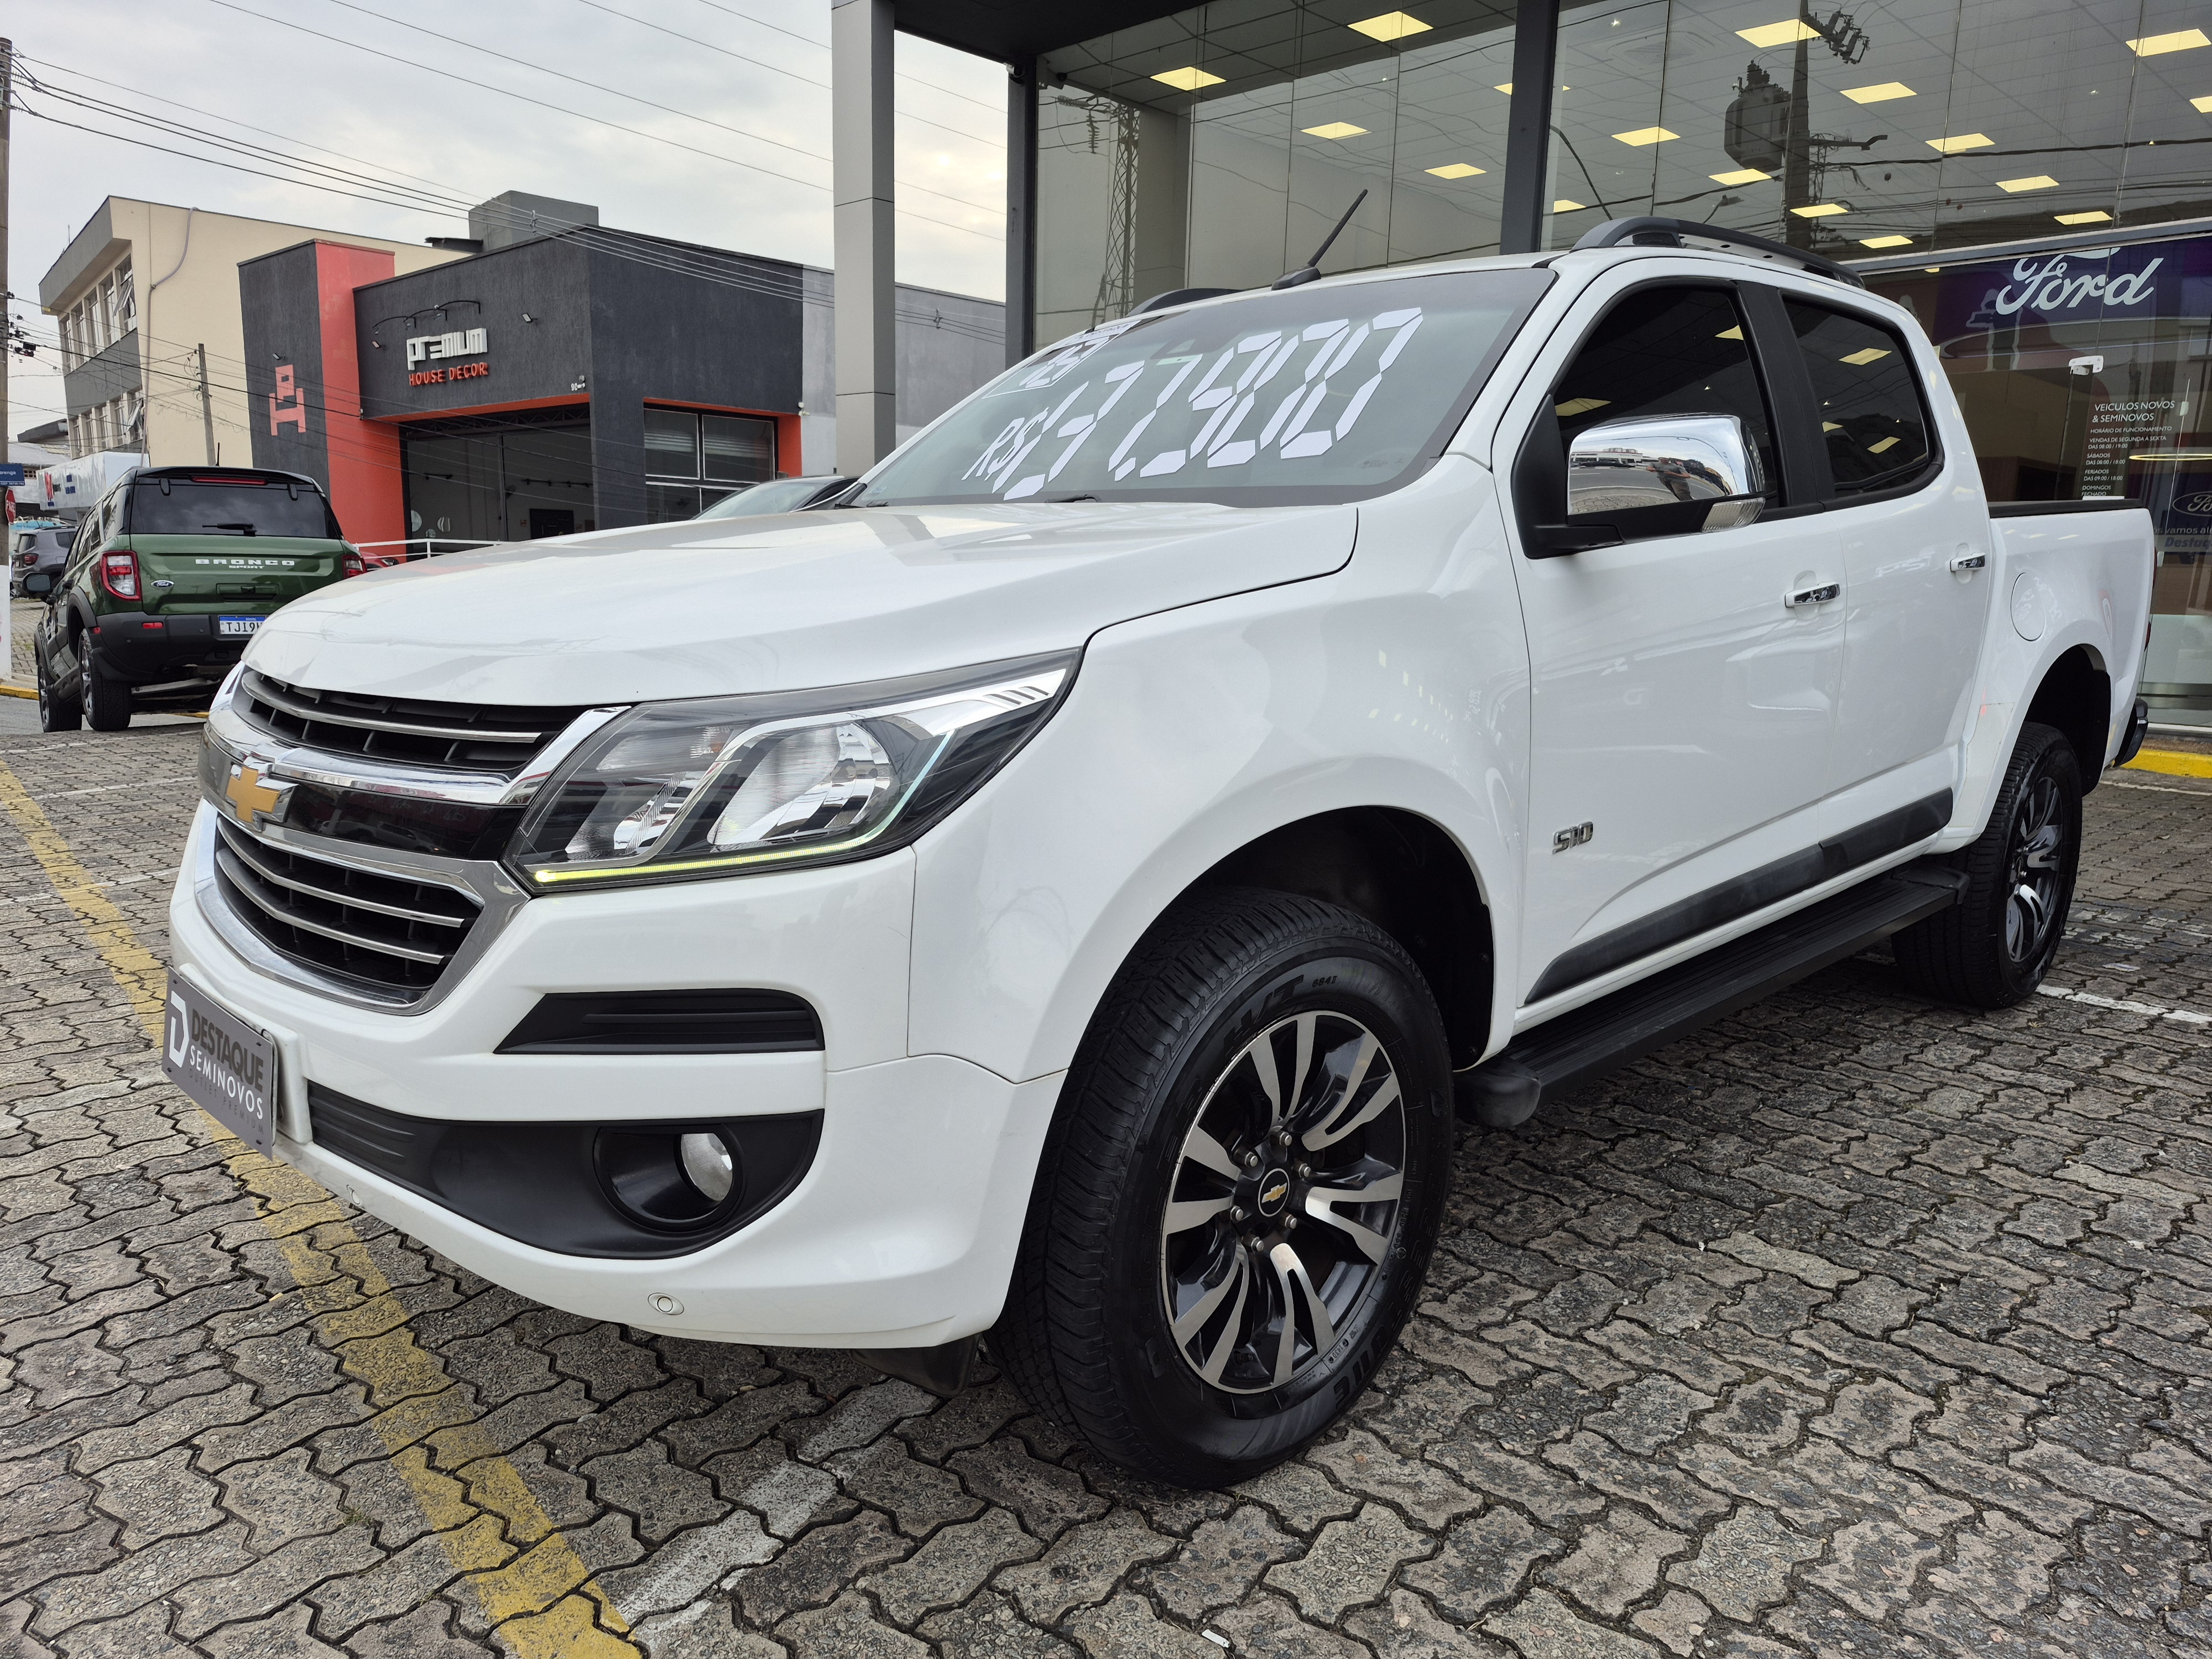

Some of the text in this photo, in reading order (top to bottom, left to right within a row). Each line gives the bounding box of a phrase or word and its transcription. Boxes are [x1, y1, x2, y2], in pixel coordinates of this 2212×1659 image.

[1995, 247, 2164, 315] Ford
[409, 362, 488, 386] HOUSE DECOR
[2095, 400, 2175, 411] VEICULOS NOVOS
[2092, 413, 2154, 423] & SEMINOVOS
[2187, 494, 2212, 512] Fo
[2164, 536, 2212, 550] Destaq
[1552, 821, 1593, 854] S10
[191, 1008, 264, 1093] DESTAQUE
[190, 1045, 263, 1120] SEMINOVOS
